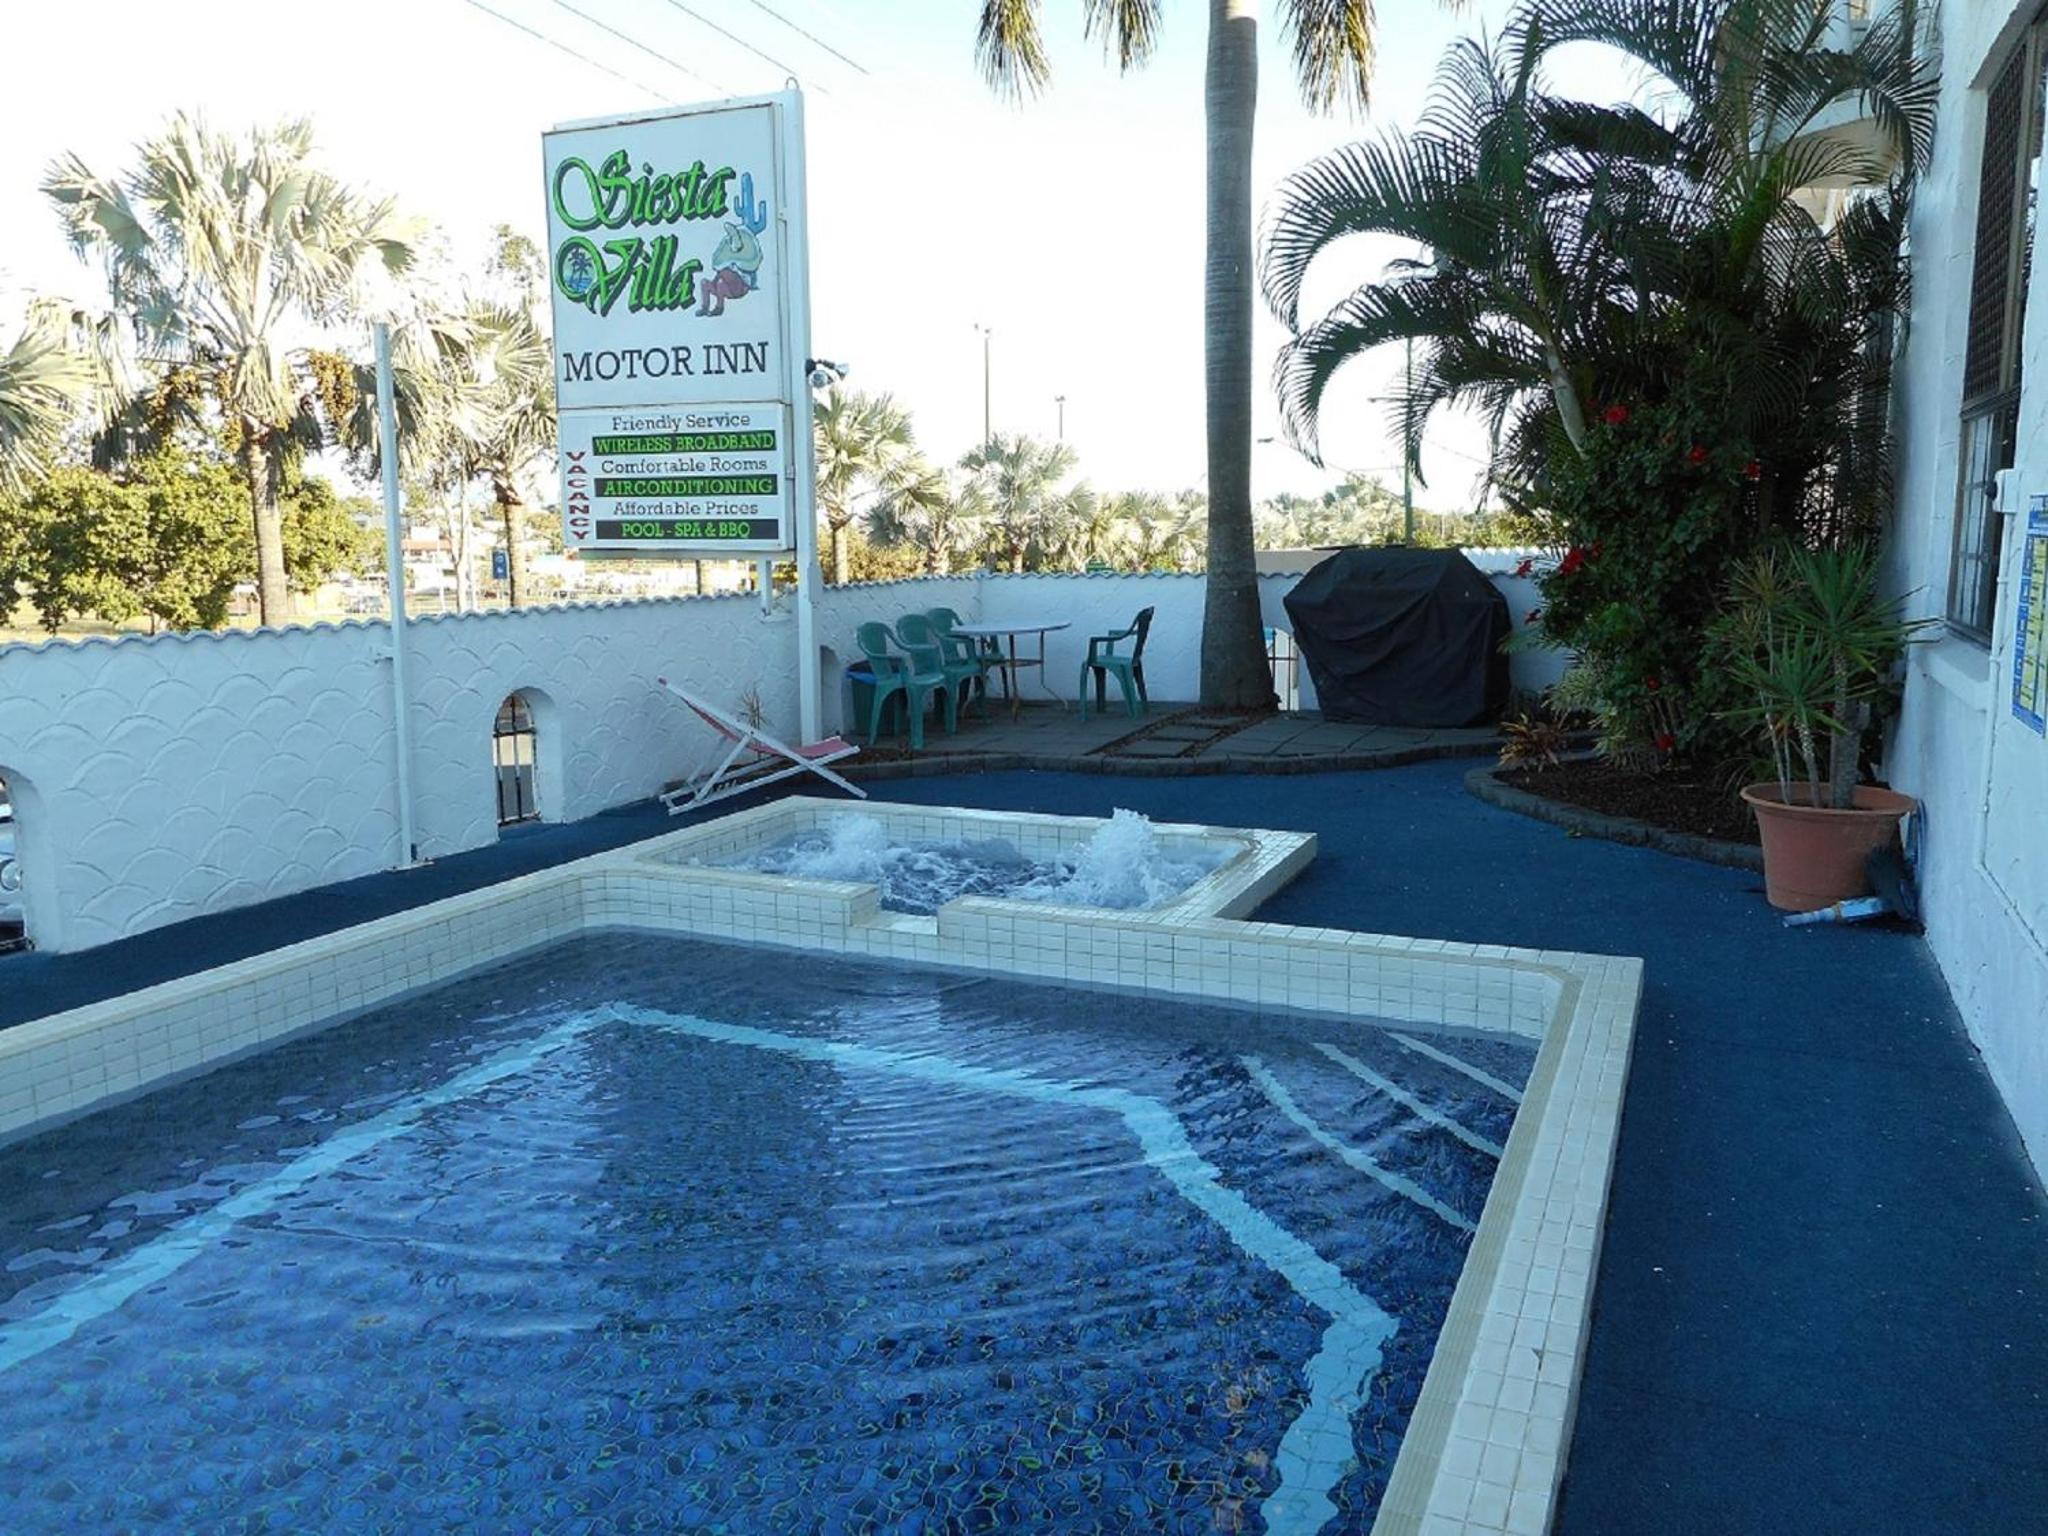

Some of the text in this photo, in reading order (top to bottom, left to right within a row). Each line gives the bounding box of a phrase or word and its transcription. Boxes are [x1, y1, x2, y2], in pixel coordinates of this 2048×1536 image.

[553, 149, 736, 232] Siesta
[554, 234, 703, 317] Villa
[563, 341, 769, 382] MOTOR INN
[612, 412, 751, 432] Friendly Service
[595, 432, 774, 454] WIRELESS BROADBAND
[601, 456, 768, 474] Comfortable Rooms
[566, 451, 590, 540] VACANCY
[603, 478, 773, 496] AIRCONDITIONING
[613, 500, 759, 516] Affordable Prices
[621, 522, 664, 538] POOL
[674, 522, 702, 538] SPA
[704, 522, 717, 538] &
